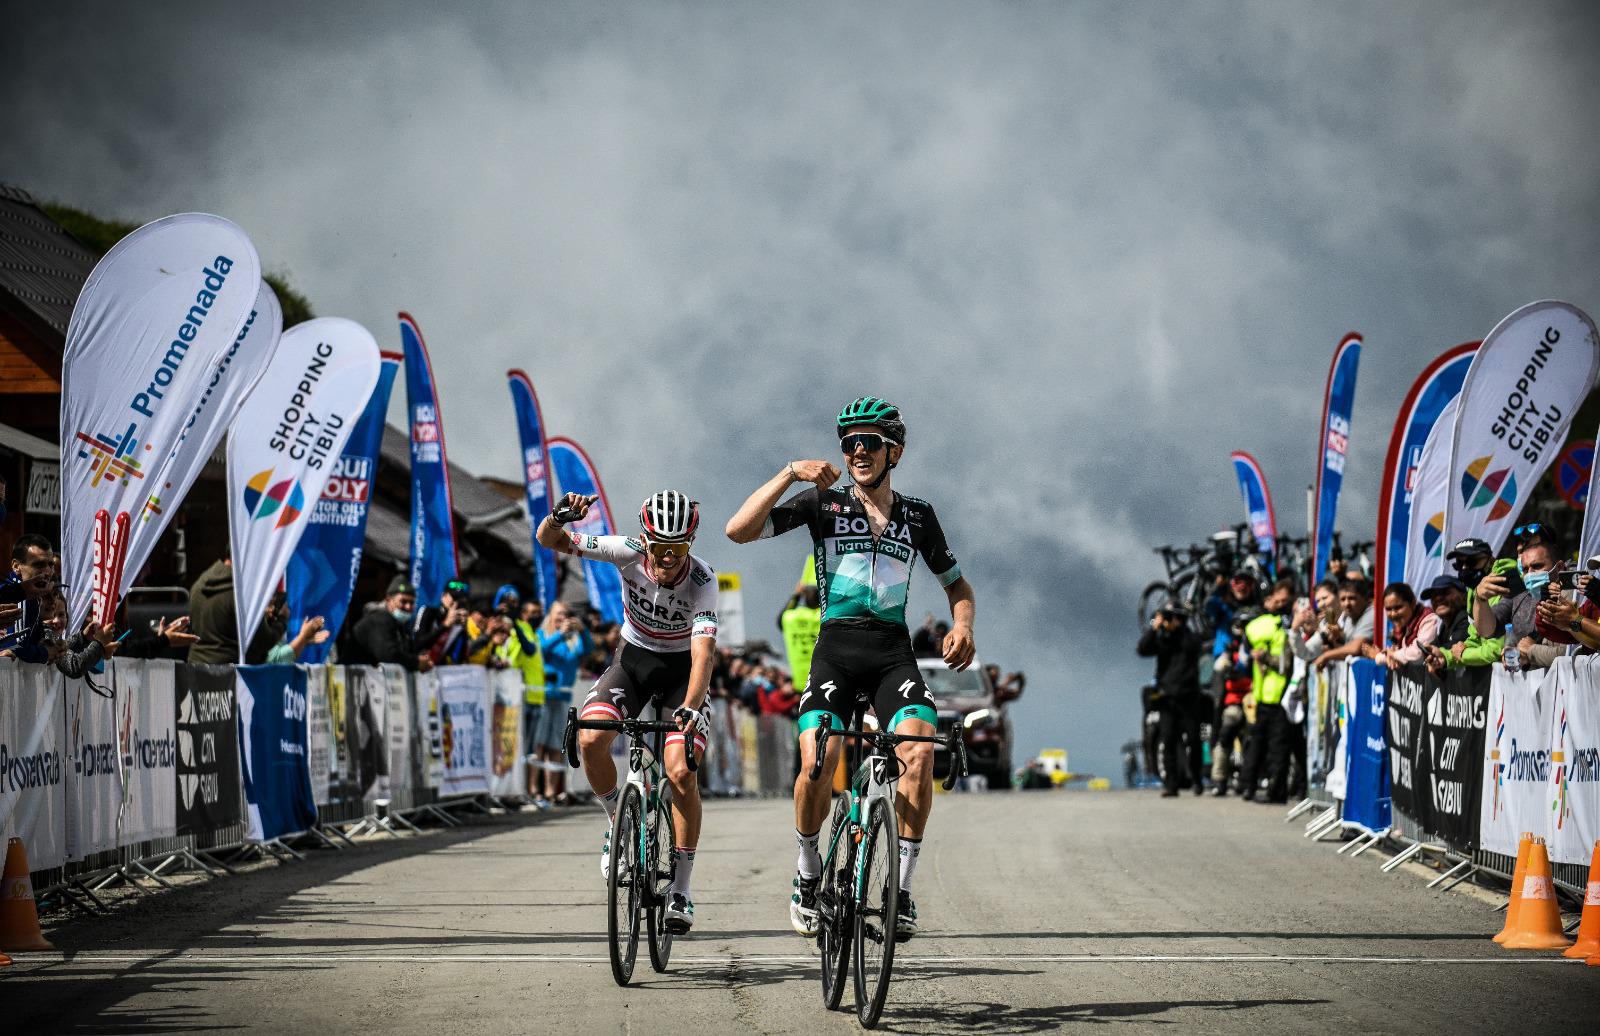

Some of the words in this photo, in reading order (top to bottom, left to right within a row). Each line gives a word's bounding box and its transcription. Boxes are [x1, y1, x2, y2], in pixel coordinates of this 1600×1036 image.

[130, 255, 234, 418] Promenada
[269, 341, 333, 452] SHOPPING
[1491, 326, 1560, 440] SHOPPING
[289, 412, 321, 461] CITY
[307, 413, 344, 470] SIBIU
[1508, 399, 1540, 451] CITY
[1523, 405, 1562, 464] SIBIU
[332, 458, 367, 479] QUI
[323, 478, 367, 500] OLY
[834, 516, 912, 545] BORA
[837, 540, 908, 560] hansrohe
[693, 567, 711, 583] BORA
[629, 588, 687, 621] BORA
[1440, 736, 1460, 771] CITY
[1437, 779, 1462, 816] SIBIU
